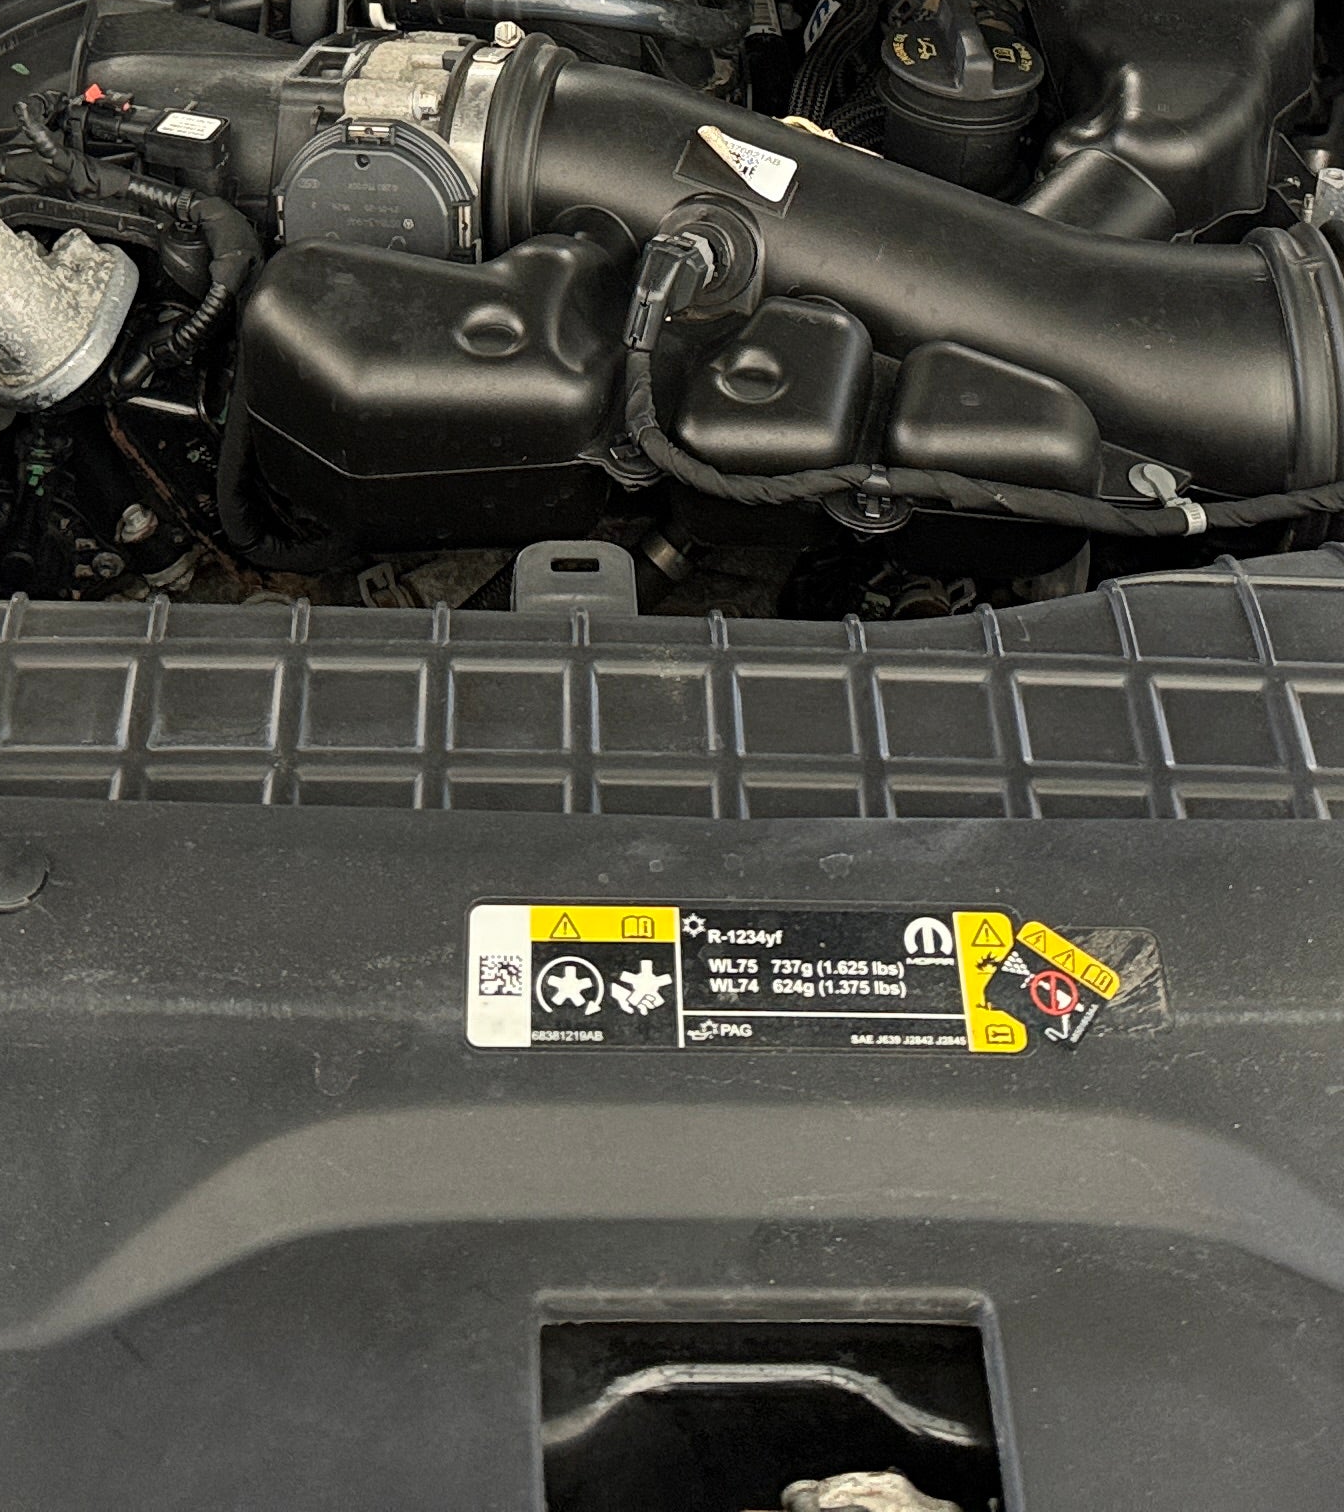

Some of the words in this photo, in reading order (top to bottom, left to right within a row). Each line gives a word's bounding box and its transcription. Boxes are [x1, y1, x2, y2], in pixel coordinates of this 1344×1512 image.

[707, 929, 784, 948] R-1234yf
[708, 958, 759, 974] WL75
[771, 959, 813, 977] 737g
[816, 960, 869, 978] (1.625
[872, 961, 905, 979] lbs)
[709, 978, 760, 994] WL74
[772, 979, 815, 998] 624g
[818, 979, 870, 998] (1.375
[873, 981, 907, 999] lbs)
[720, 1024, 753, 1037] PAG
[851, 1034, 875, 1045] SAE
